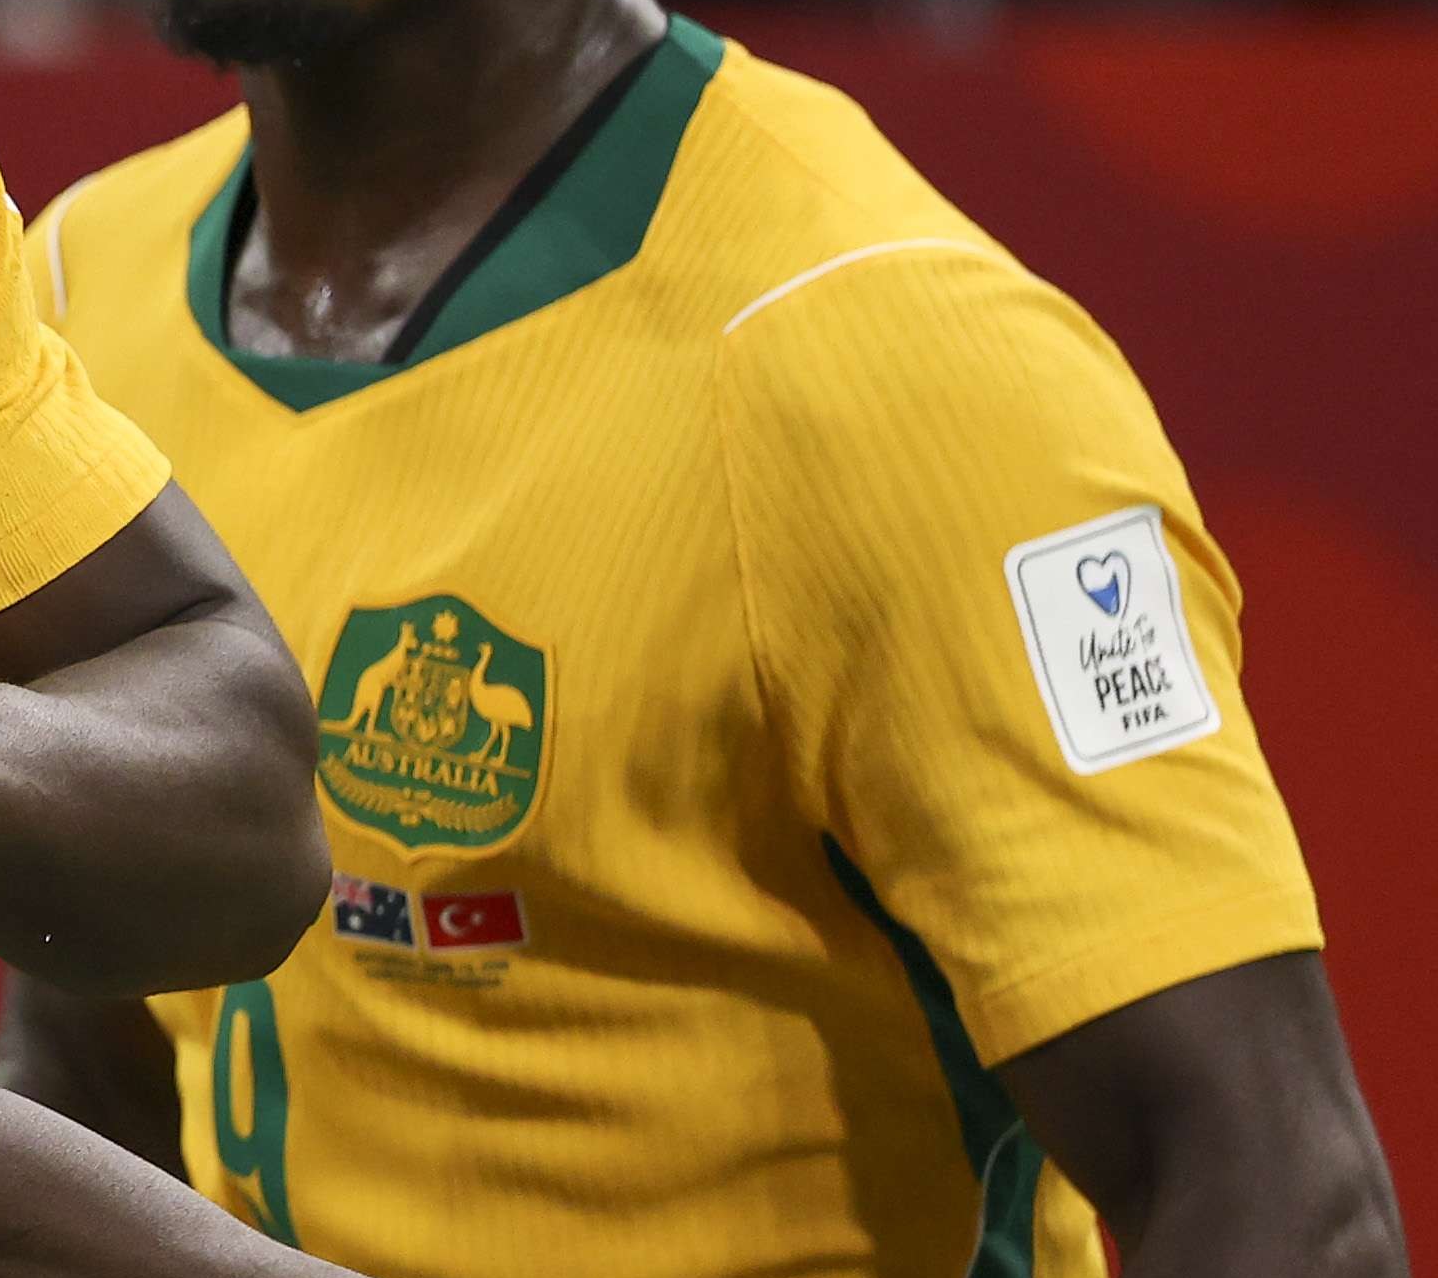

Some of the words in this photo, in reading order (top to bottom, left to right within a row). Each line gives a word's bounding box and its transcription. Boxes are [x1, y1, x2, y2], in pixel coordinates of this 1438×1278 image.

[1095, 655, 1173, 712] PEACE
[1122, 702, 1170, 733] FIFA
[342, 742, 502, 797] AUSTRALIA
